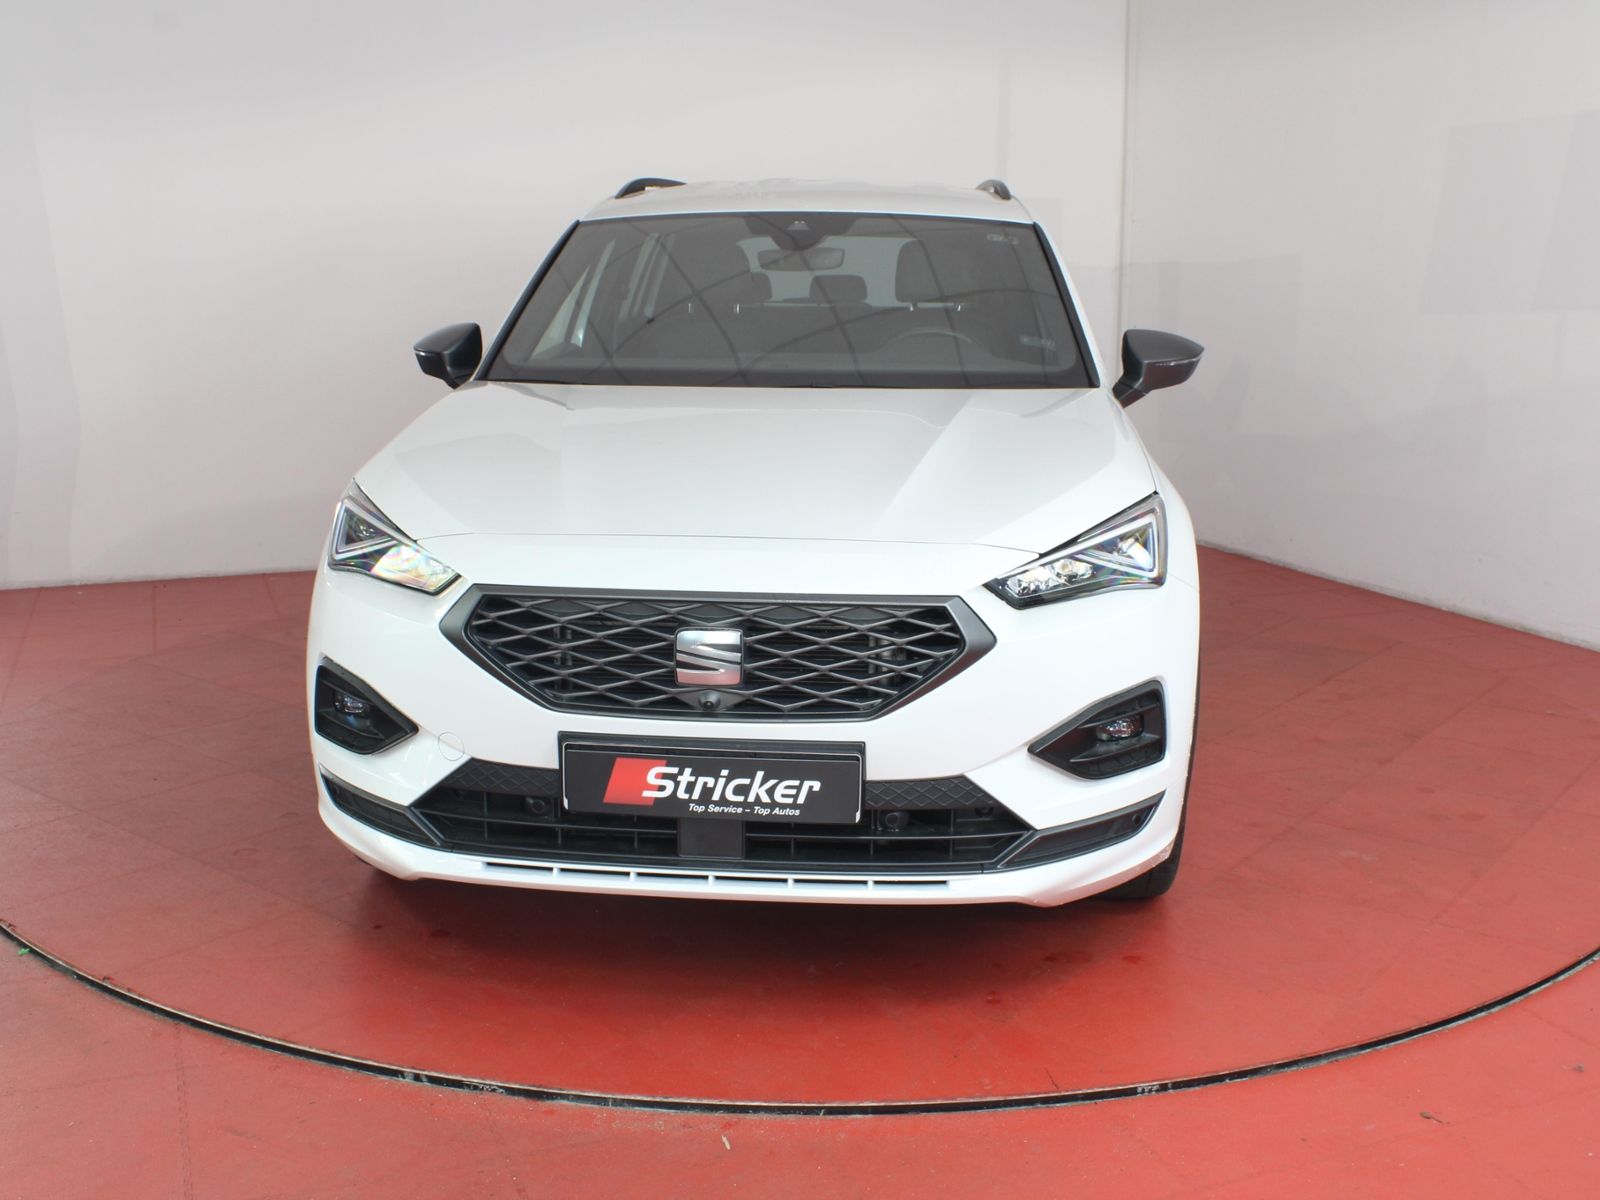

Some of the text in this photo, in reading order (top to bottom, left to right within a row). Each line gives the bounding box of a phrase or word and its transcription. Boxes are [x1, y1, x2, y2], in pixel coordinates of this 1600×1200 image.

[642, 766, 822, 805] Stricker
[688, 803, 706, 813] Top
[707, 804, 743, 814] Service
[753, 806, 771, 816] Top
[772, 807, 801, 816] Autos
